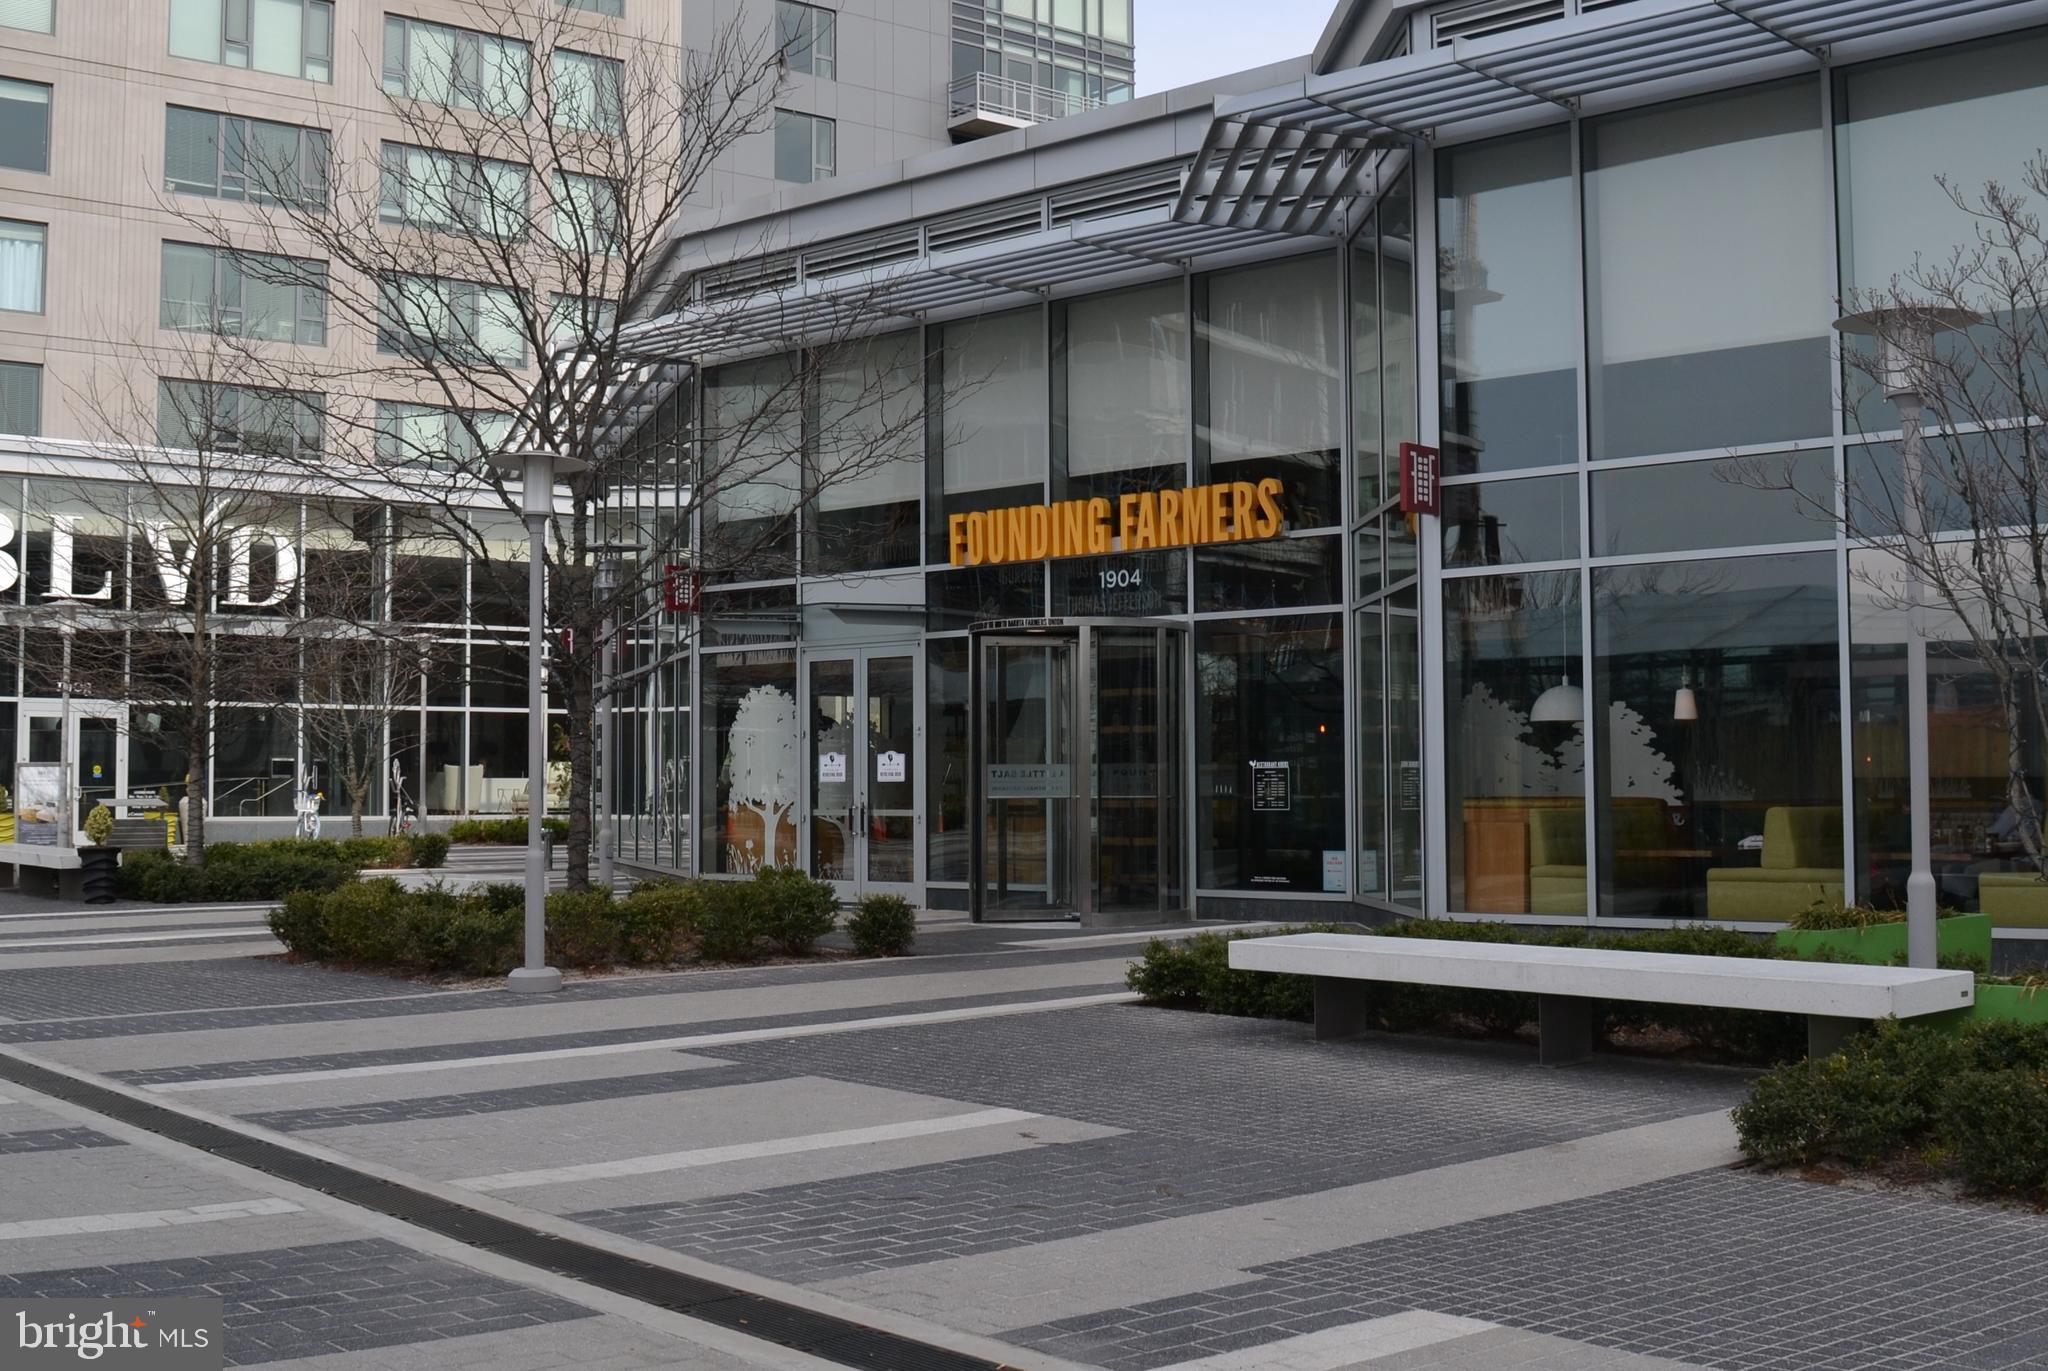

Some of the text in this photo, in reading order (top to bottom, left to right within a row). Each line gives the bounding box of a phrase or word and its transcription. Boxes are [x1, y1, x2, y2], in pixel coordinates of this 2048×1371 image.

[949, 477, 1283, 567] FOUNDING FARMERS
[1098, 568, 1142, 590] 1904
